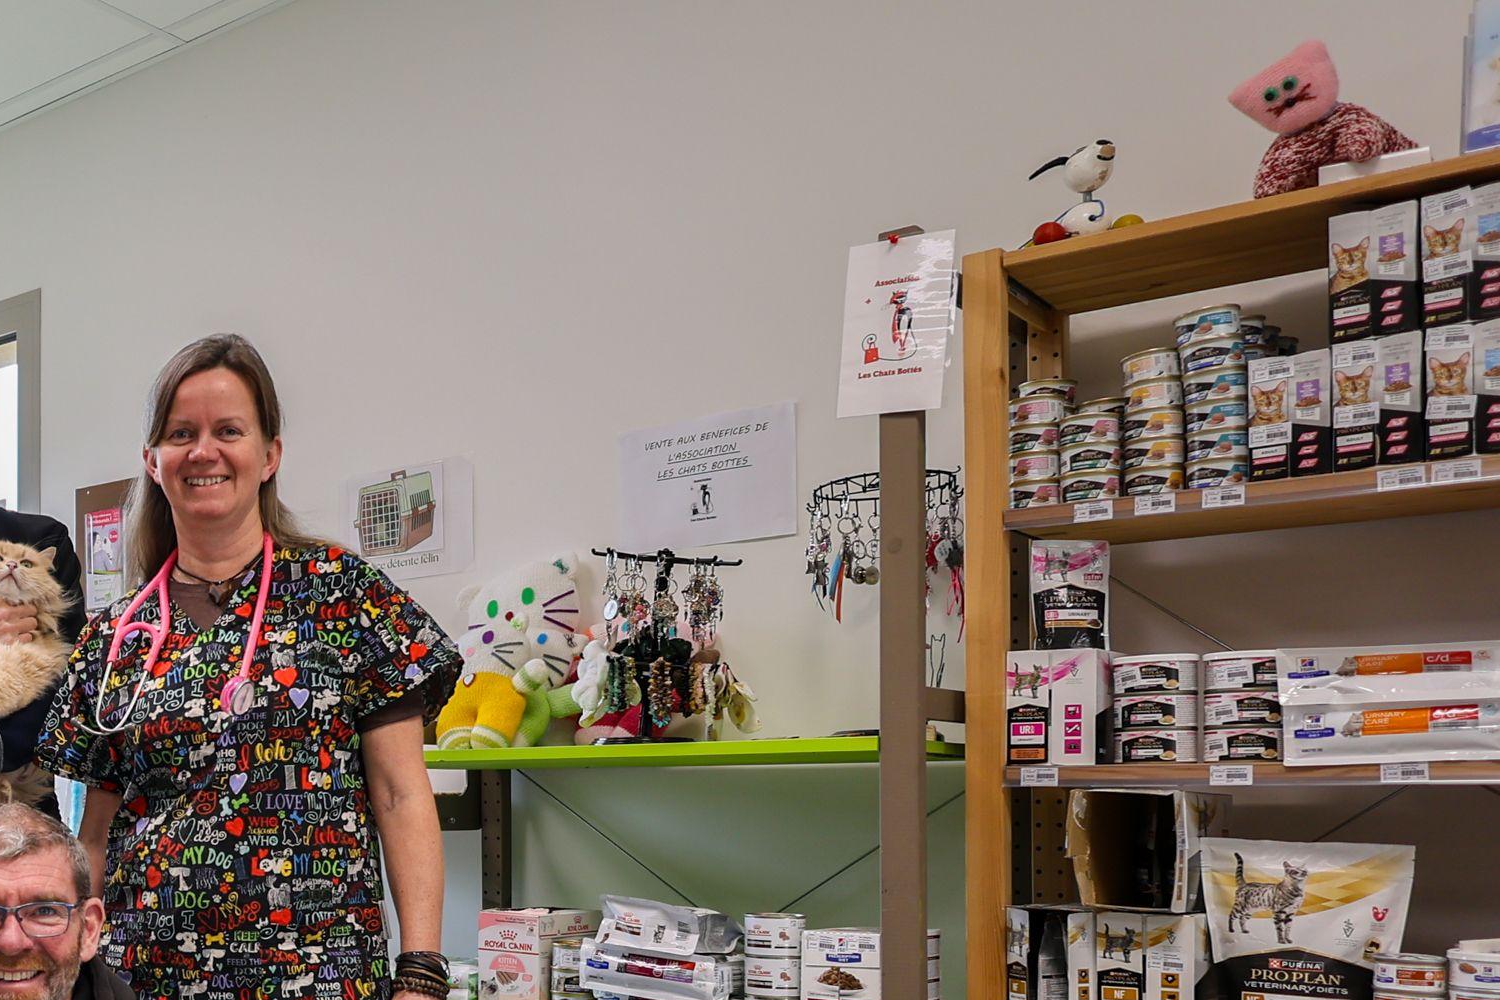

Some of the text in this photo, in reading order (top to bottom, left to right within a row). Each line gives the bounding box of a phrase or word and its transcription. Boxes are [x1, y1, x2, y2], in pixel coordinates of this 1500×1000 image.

[873, 369, 895, 377] Chats
[897, 366, 922, 375] Bottés
[644, 422, 770, 451] VENTE AUX BENEFICES DE
[668, 443, 737, 462] L'ASSOCIATION
[657, 456, 749, 479] LES CHATS BOTTES
[387, 553, 439, 569] détente félin
[216, 630, 241, 644] DOG
[317, 631, 357, 648] DOG
[1426, 654, 1450, 663] c/d
[166, 662, 219, 686] MY DOG
[148, 687, 185, 711] Dog
[273, 708, 308, 727] MY
[1364, 711, 1405, 719] URINARY
[151, 749, 183, 765] DOG
[265, 794, 303, 809] LOVE
[248, 817, 278, 827] WHO
[248, 835, 278, 846] WHO
[182, 846, 233, 869] MY DOG
[294, 854, 344, 877] MY DOG
[160, 886, 210, 908] MY DOG
[147, 911, 175, 941] Dog
[330, 926, 352, 936] KEEP
[484, 940, 533, 951] ROYAL CANIN
[106, 957, 122, 966] WHO
[182, 969, 200, 979] LOVE
[287, 964, 306, 975] LOVE
[319, 964, 338, 980] DOG
[1251, 969, 1341, 985] PRO PLAN
[212, 974, 234, 989] DOG
[314, 982, 341, 991] WHO
[1244, 980, 1348, 994] VETERINARY DIETS
[208, 992, 234, 1000] WHO
[1114, 990, 1125, 999] NF
